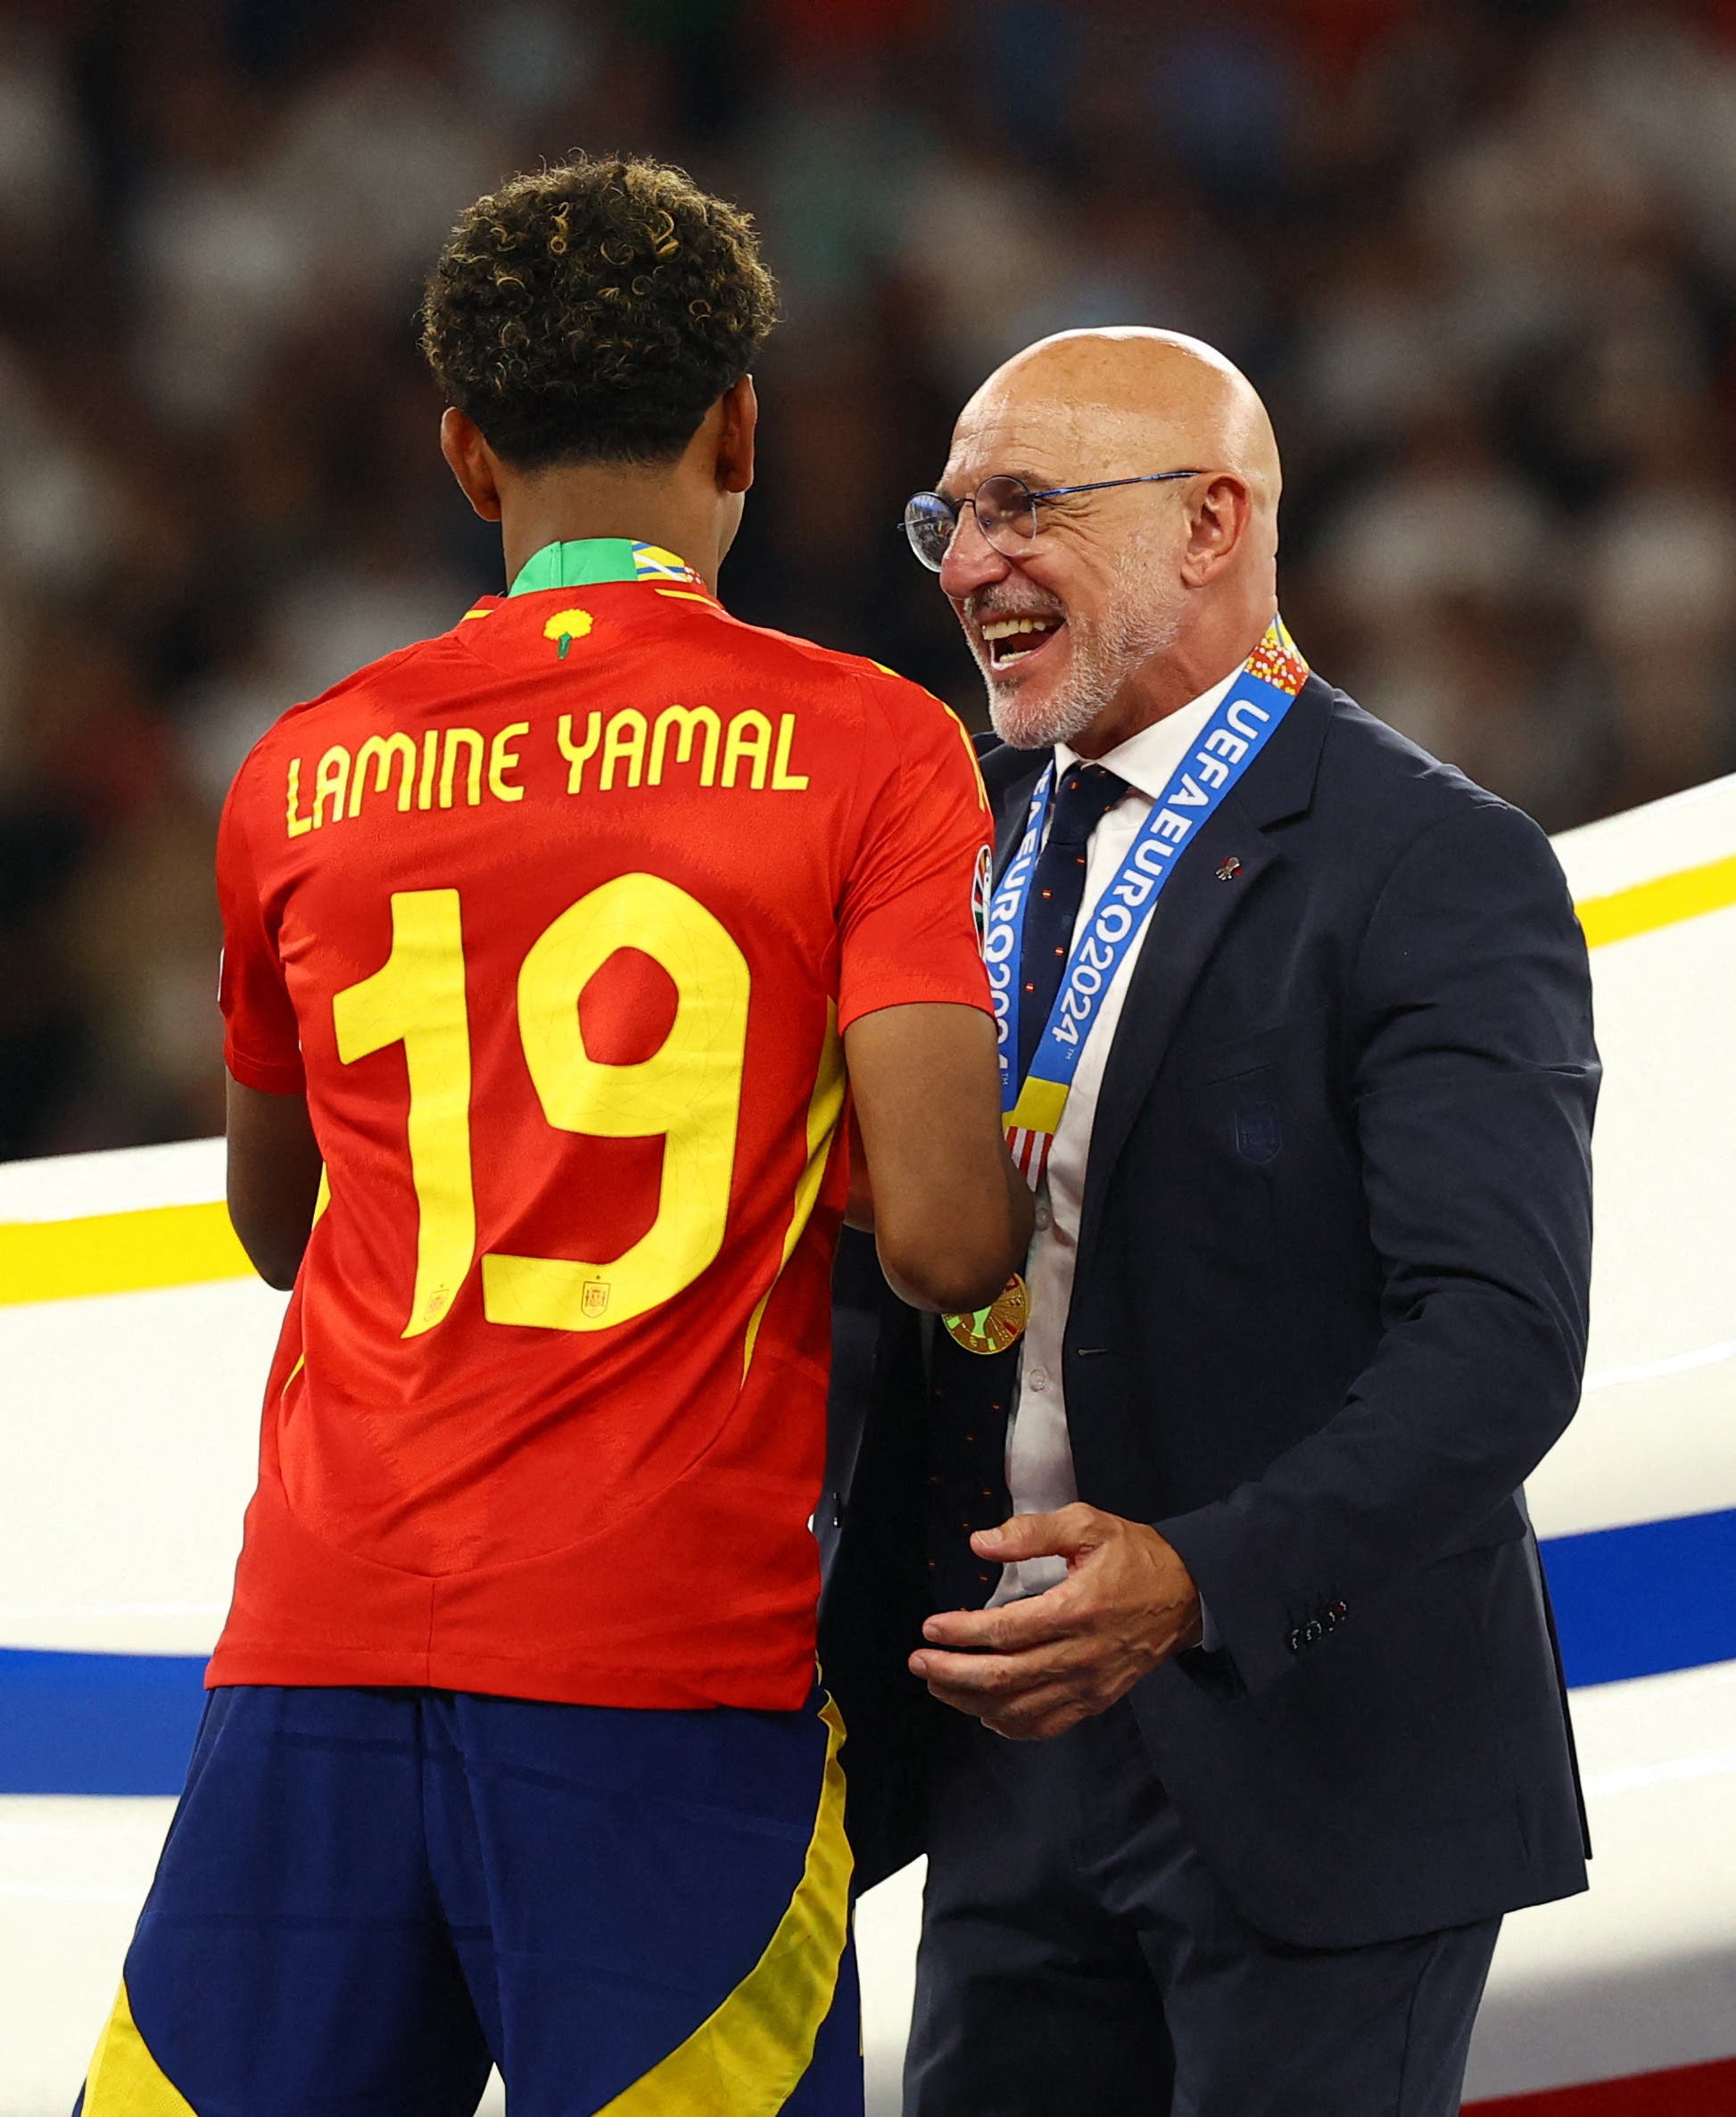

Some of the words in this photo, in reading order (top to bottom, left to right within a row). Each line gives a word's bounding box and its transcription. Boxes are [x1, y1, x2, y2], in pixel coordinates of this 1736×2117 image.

[287, 721, 530, 839] LAMINE
[558, 704, 809, 795] YAMAL
[333, 872, 751, 1338] 19
